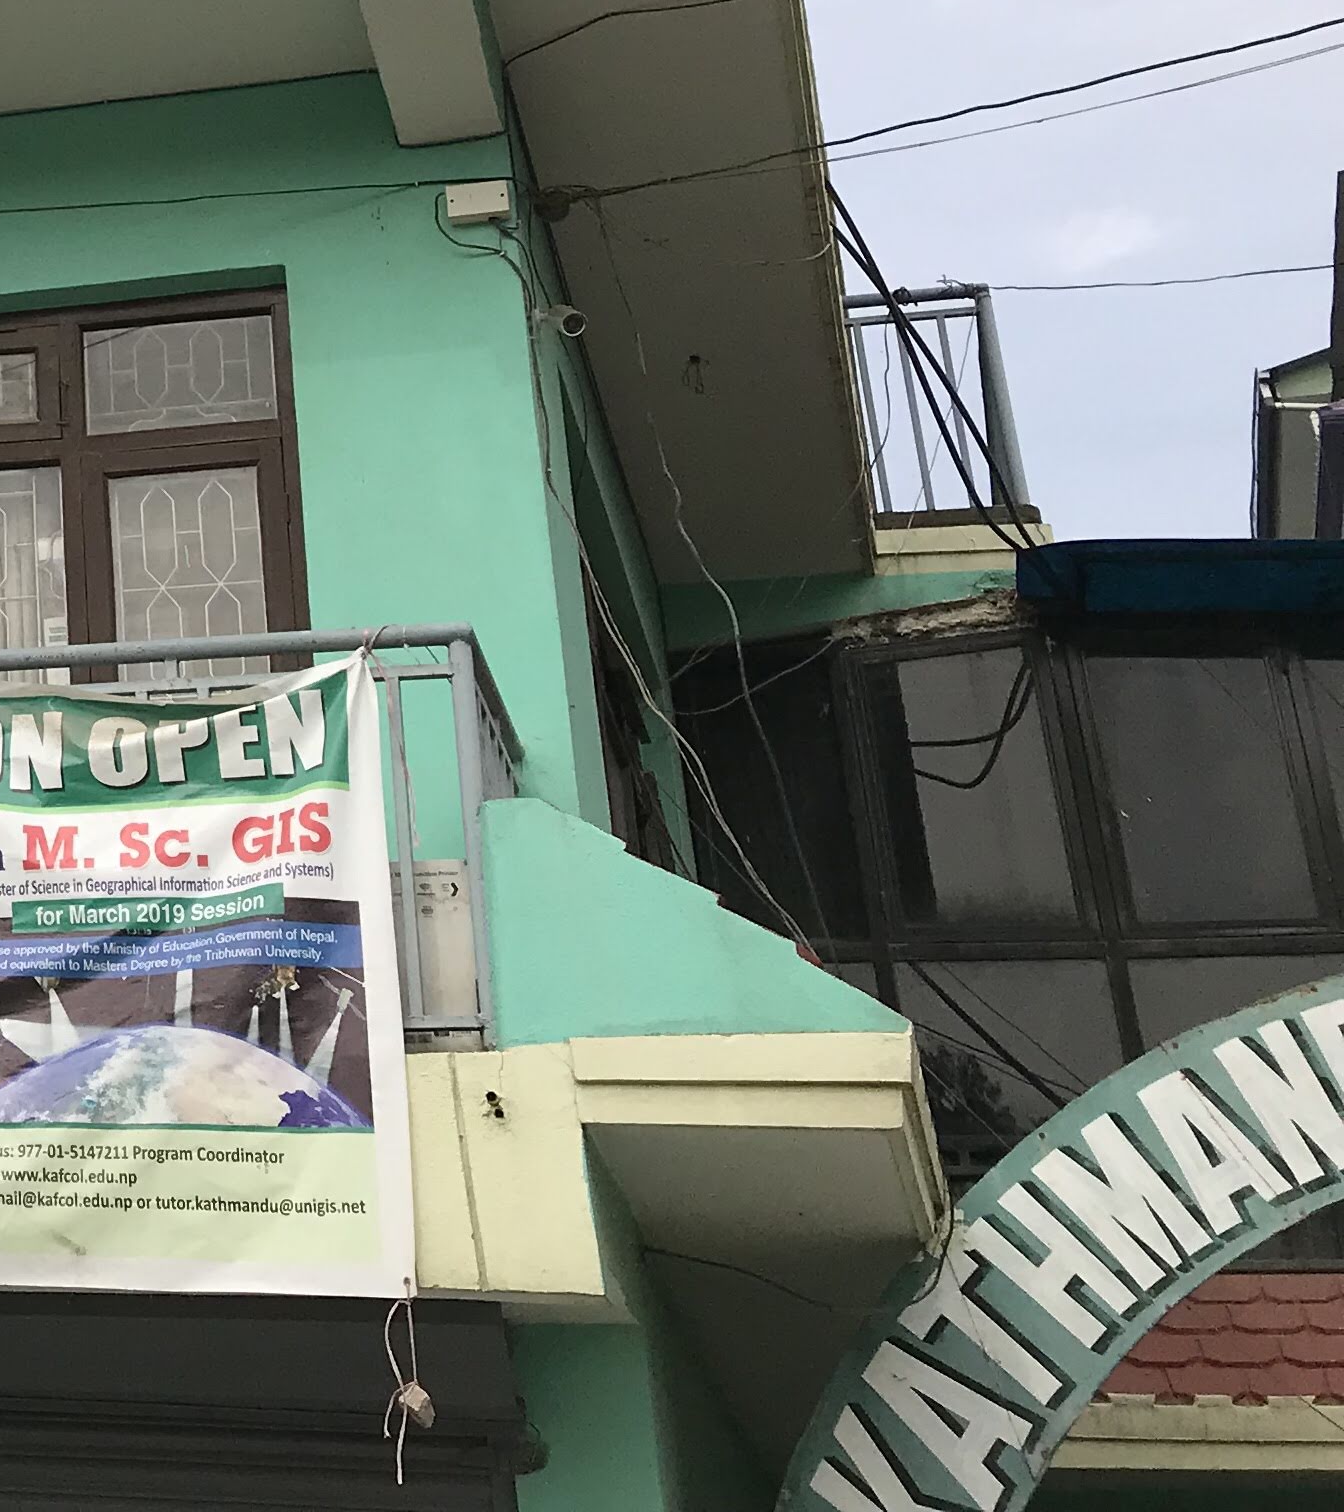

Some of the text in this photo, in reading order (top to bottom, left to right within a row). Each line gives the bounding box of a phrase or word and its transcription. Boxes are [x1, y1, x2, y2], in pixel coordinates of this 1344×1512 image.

[87, 688, 326, 788] OPEN
[22, 824, 95, 872] M.
[118, 821, 209, 870] Sc.
[231, 802, 333, 865] GIS
[19, 880, 29, 896] of
[32, 879, 70, 895] Science
[73, 878, 83, 893] in
[85, 876, 156, 896] Geographical
[159, 875, 224, 892] Information
[227, 871, 262, 889] Science
[263, 863, 282, 879] and
[284, 862, 334, 881] Systems)
[36, 893, 265, 927] for March 2019 Session
[13, 943, 63, 956] approved
[66, 943, 80, 955] by
[82, 942, 100, 954] the
[103, 941, 147, 957] Ministry
[149, 943, 160, 954] of
[286, 929, 297, 941] of
[10, 959, 65, 971] equivalent
[69, 960, 80, 971] to
[130, 958, 168, 971] Degree
[171, 956, 182, 968] by
[186, 953, 201, 964] the
[17, 1144, 129, 1160] 977-01-5147211
[133, 1145, 193, 1164] Program
[197, 1147, 284, 1164] Coordinator
[1, 1168, 137, 1187] www.kafcol.edu.np
[136, 1197, 152, 1210] or
[156, 1195, 367, 1217] tutor.kathmandu@unigis.net
